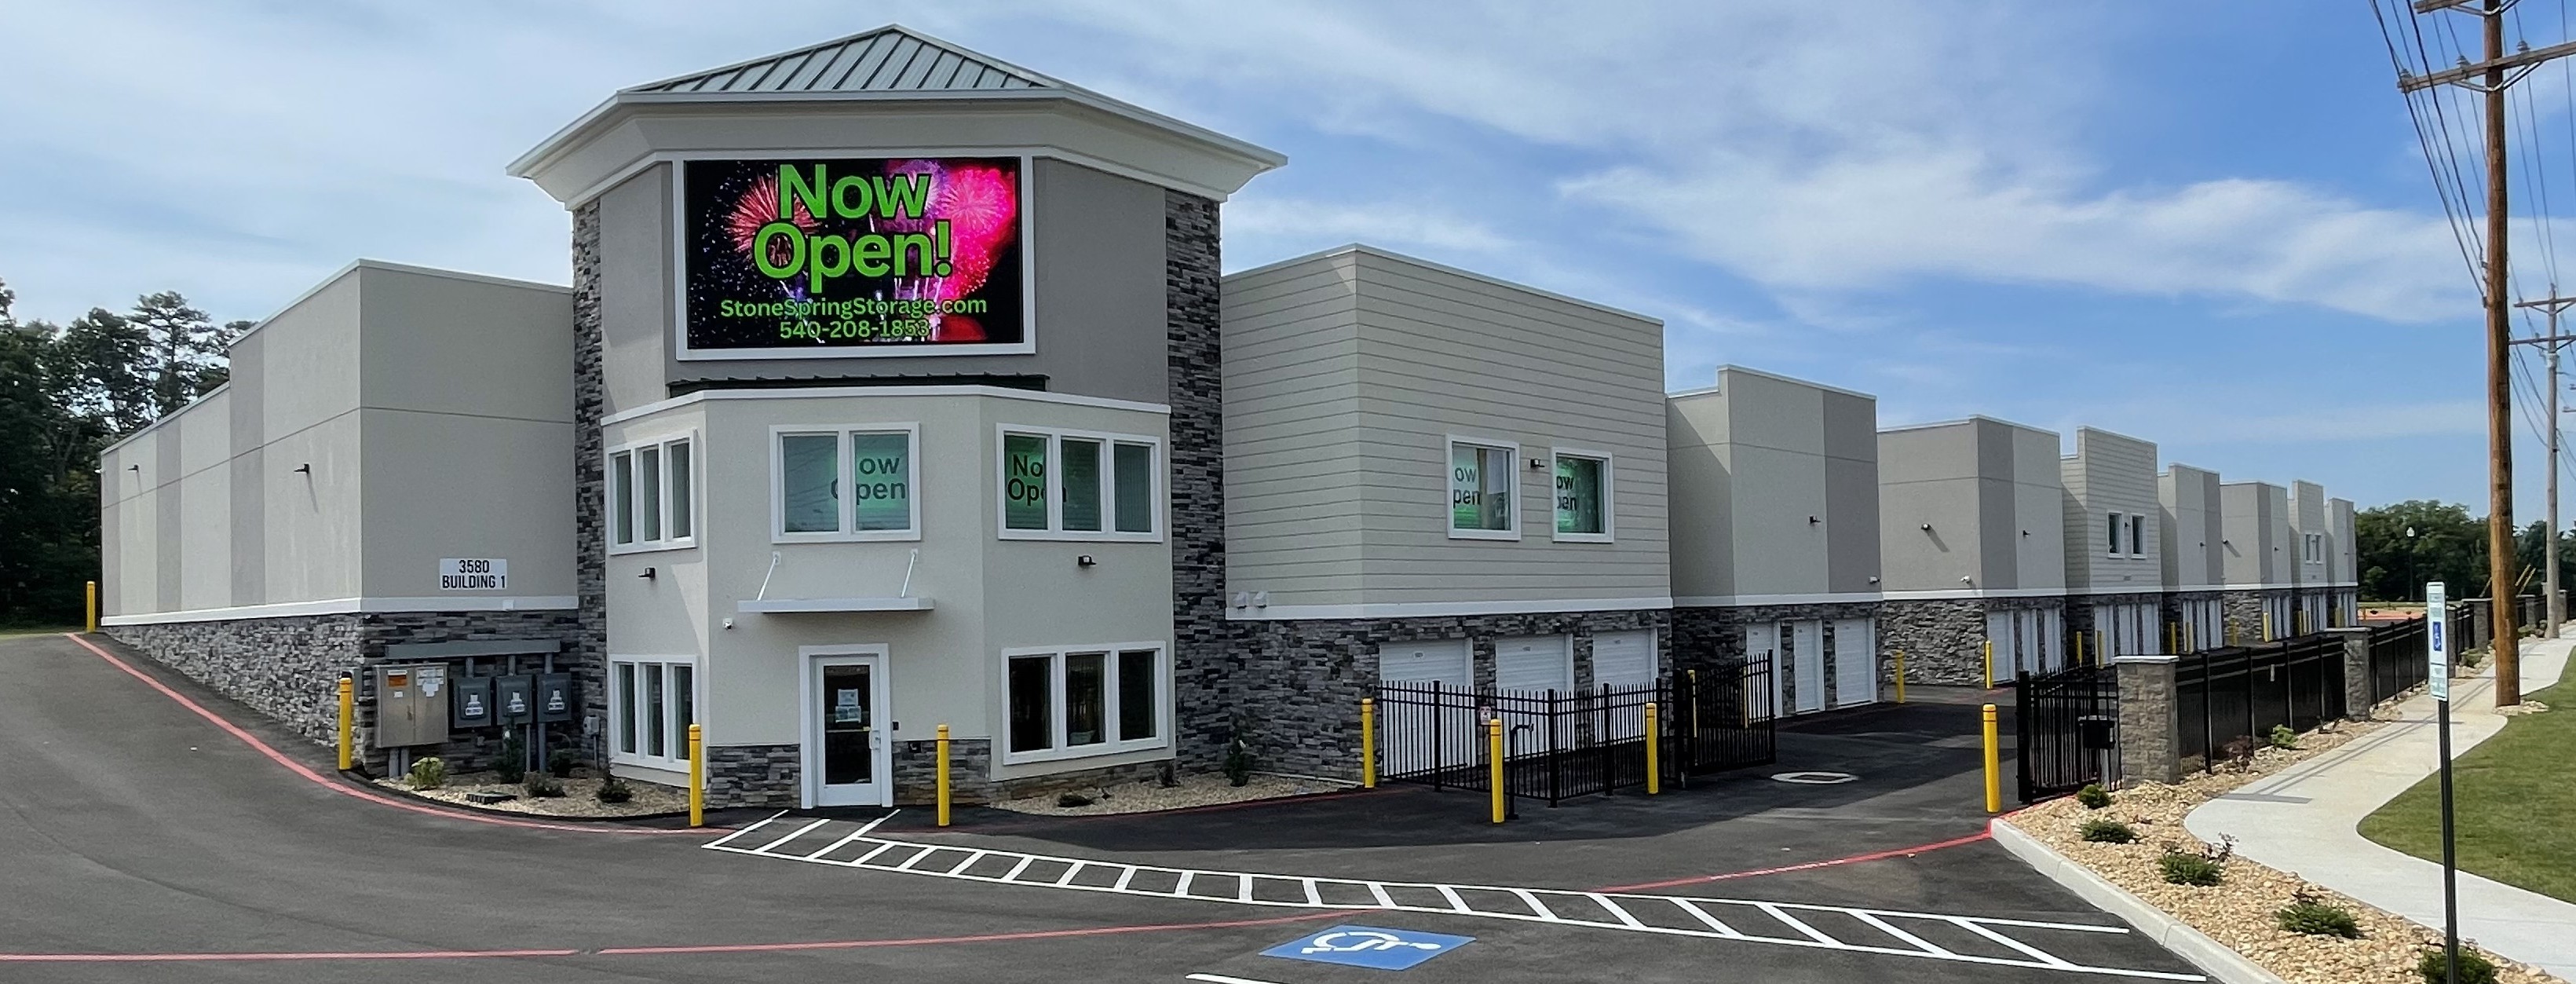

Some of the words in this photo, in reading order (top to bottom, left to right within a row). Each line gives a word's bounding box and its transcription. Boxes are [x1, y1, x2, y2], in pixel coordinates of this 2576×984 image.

[780, 163, 930, 219] Now
[754, 221, 952, 294] Open!
[721, 298, 987, 319] StoneSpringStorage.com
[780, 320, 930, 339] 540-208-1853
[860, 458, 900, 474] ow
[1013, 454, 1043, 477] No
[1455, 467, 1477, 483] ow
[1556, 476, 1574, 490] ow
[1453, 488, 1481, 509] pen
[459, 559, 490, 573] 3580
[442, 575, 495, 588] BUILDING
[501, 575, 506, 588] 1
